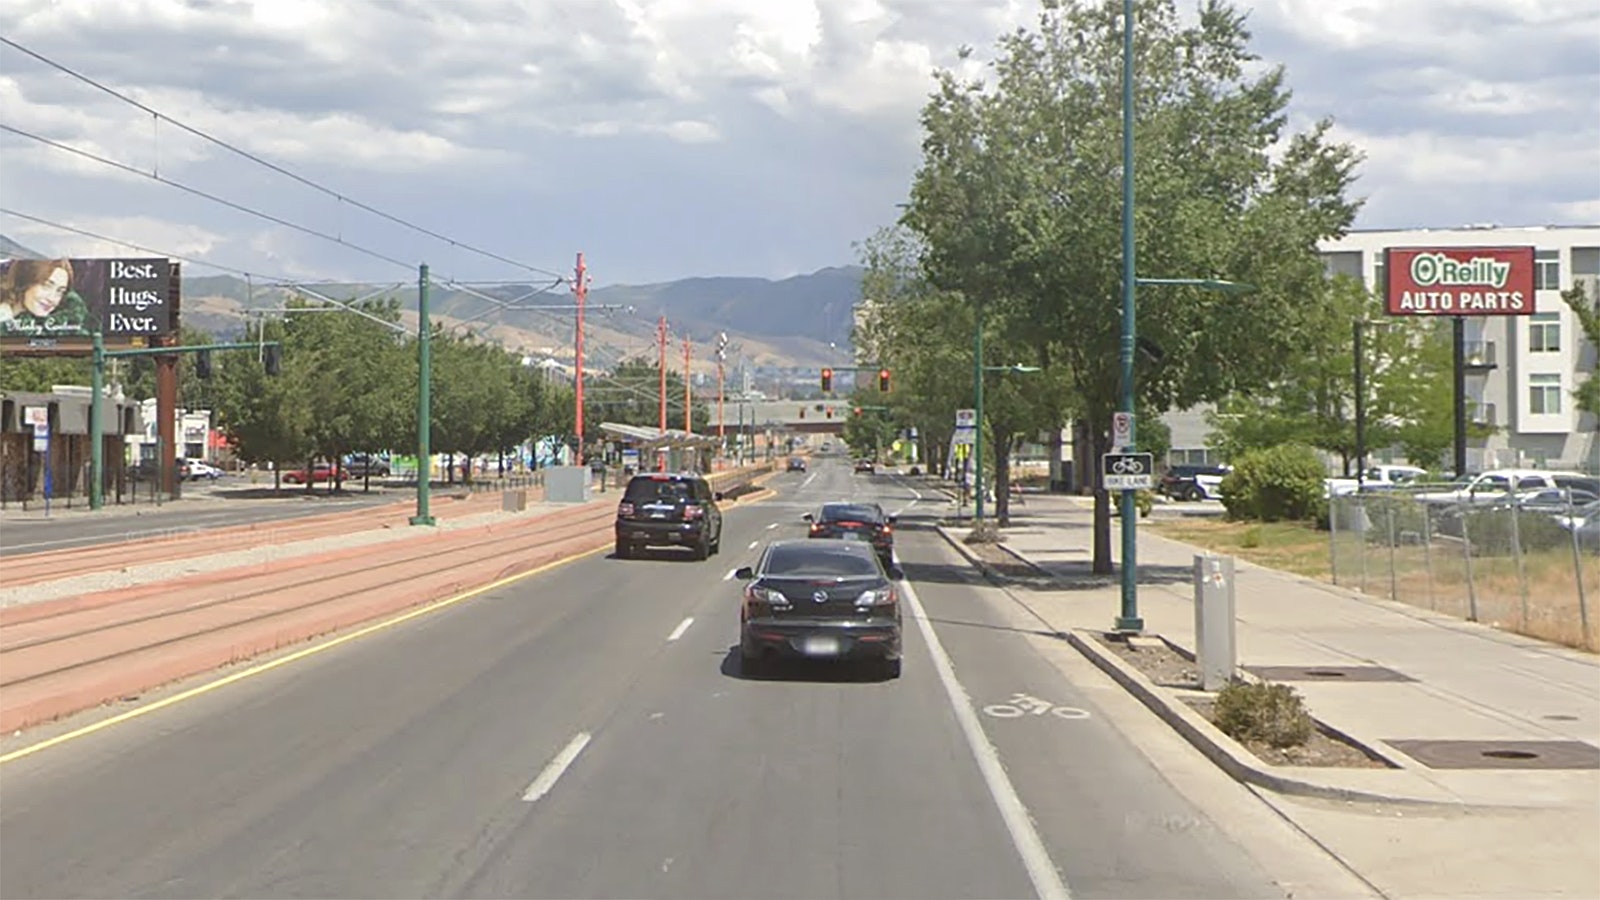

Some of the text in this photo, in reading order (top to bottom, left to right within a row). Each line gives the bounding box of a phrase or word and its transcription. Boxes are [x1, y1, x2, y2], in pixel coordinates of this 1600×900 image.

[110, 261, 158, 279] Best.
[1412, 254, 1509, 287] O'Reilly
[110, 287, 163, 311] Hugs.
[1400, 291, 1524, 310] AUTO PARTS
[110, 313, 158, 331] Ever.
[1127, 476, 1148, 486] LANE
